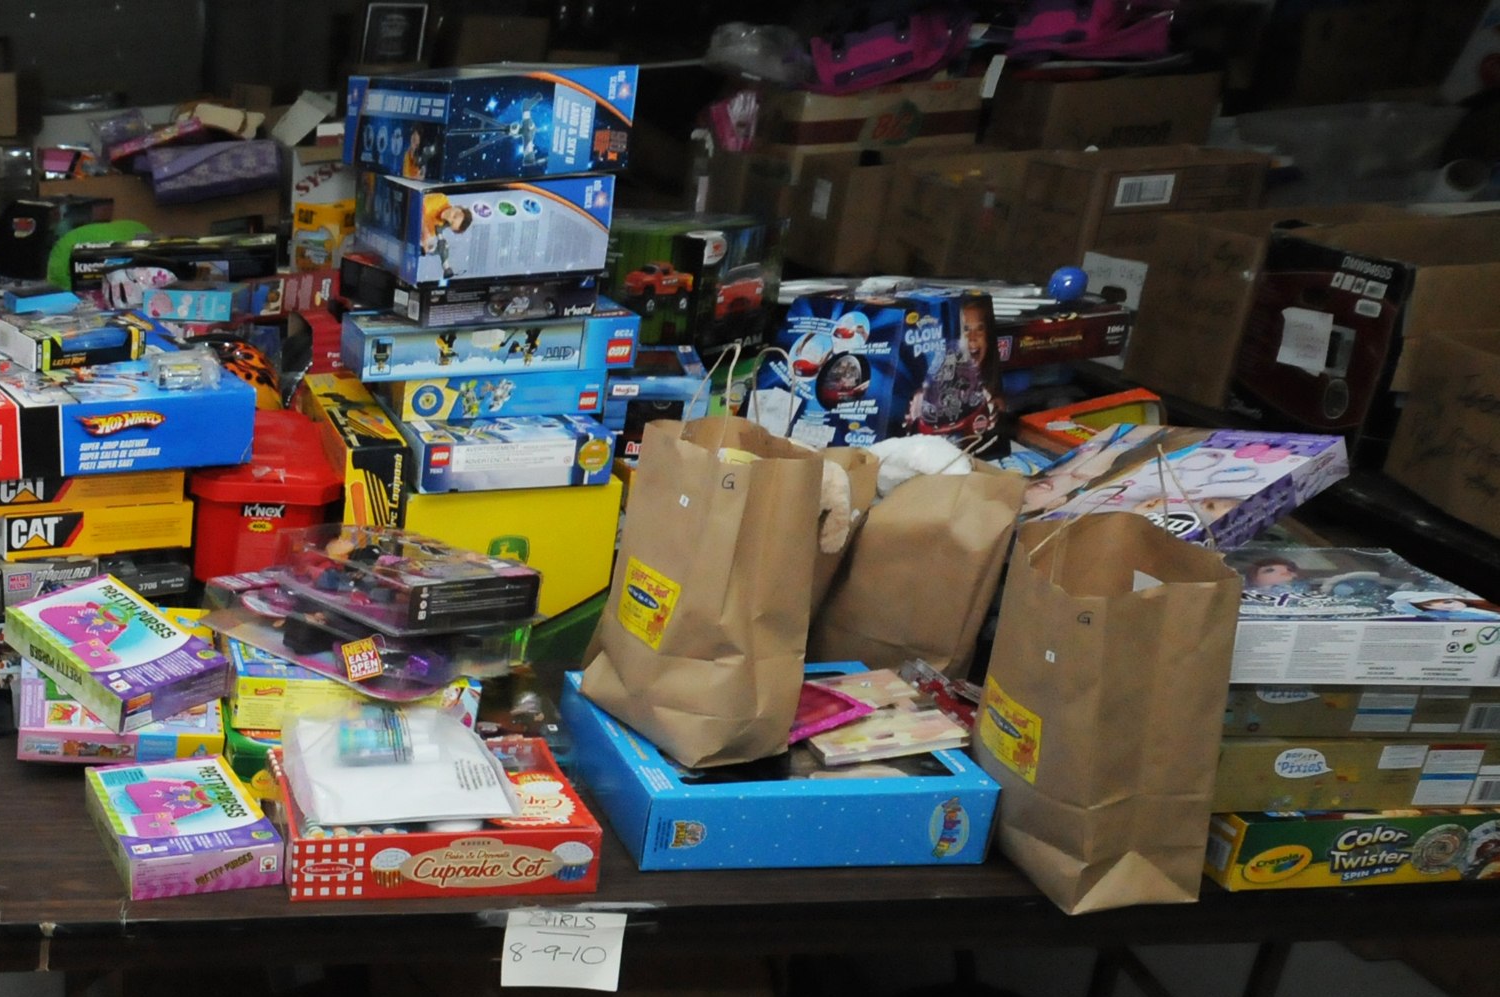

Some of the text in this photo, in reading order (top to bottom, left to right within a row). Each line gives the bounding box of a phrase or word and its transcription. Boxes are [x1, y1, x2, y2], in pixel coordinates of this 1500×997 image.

[905, 325, 944, 345] GLOW
[608, 345, 631, 359] LEGO
[913, 339, 947, 358] DOME
[844, 432, 877, 446] GLOW
[431, 451, 449, 462] LEGO
[721, 472, 737, 491] G
[244, 503, 286, 518] K'NEX
[11, 516, 60, 550] CAT
[33, 565, 92, 584] PROBUILDER
[99, 584, 178, 641] PRETTY PURSES
[344, 640, 373, 655] NEW
[349, 650, 377, 665] EASY
[349, 659, 380, 674] OPEN
[199, 765, 228, 792] PRETTY
[1337, 826, 1409, 851] Color
[195, 851, 254, 887] PRETTY PURSES
[1256, 852, 1300, 868] Crayola
[1330, 849, 1411, 871] Twister
[413, 857, 553, 888] Cupcake Set
[1342, 870, 1370, 881] SPIN
[529, 912, 597, 931] GIRLS
[509, 941, 607, 966] 8-9-10
